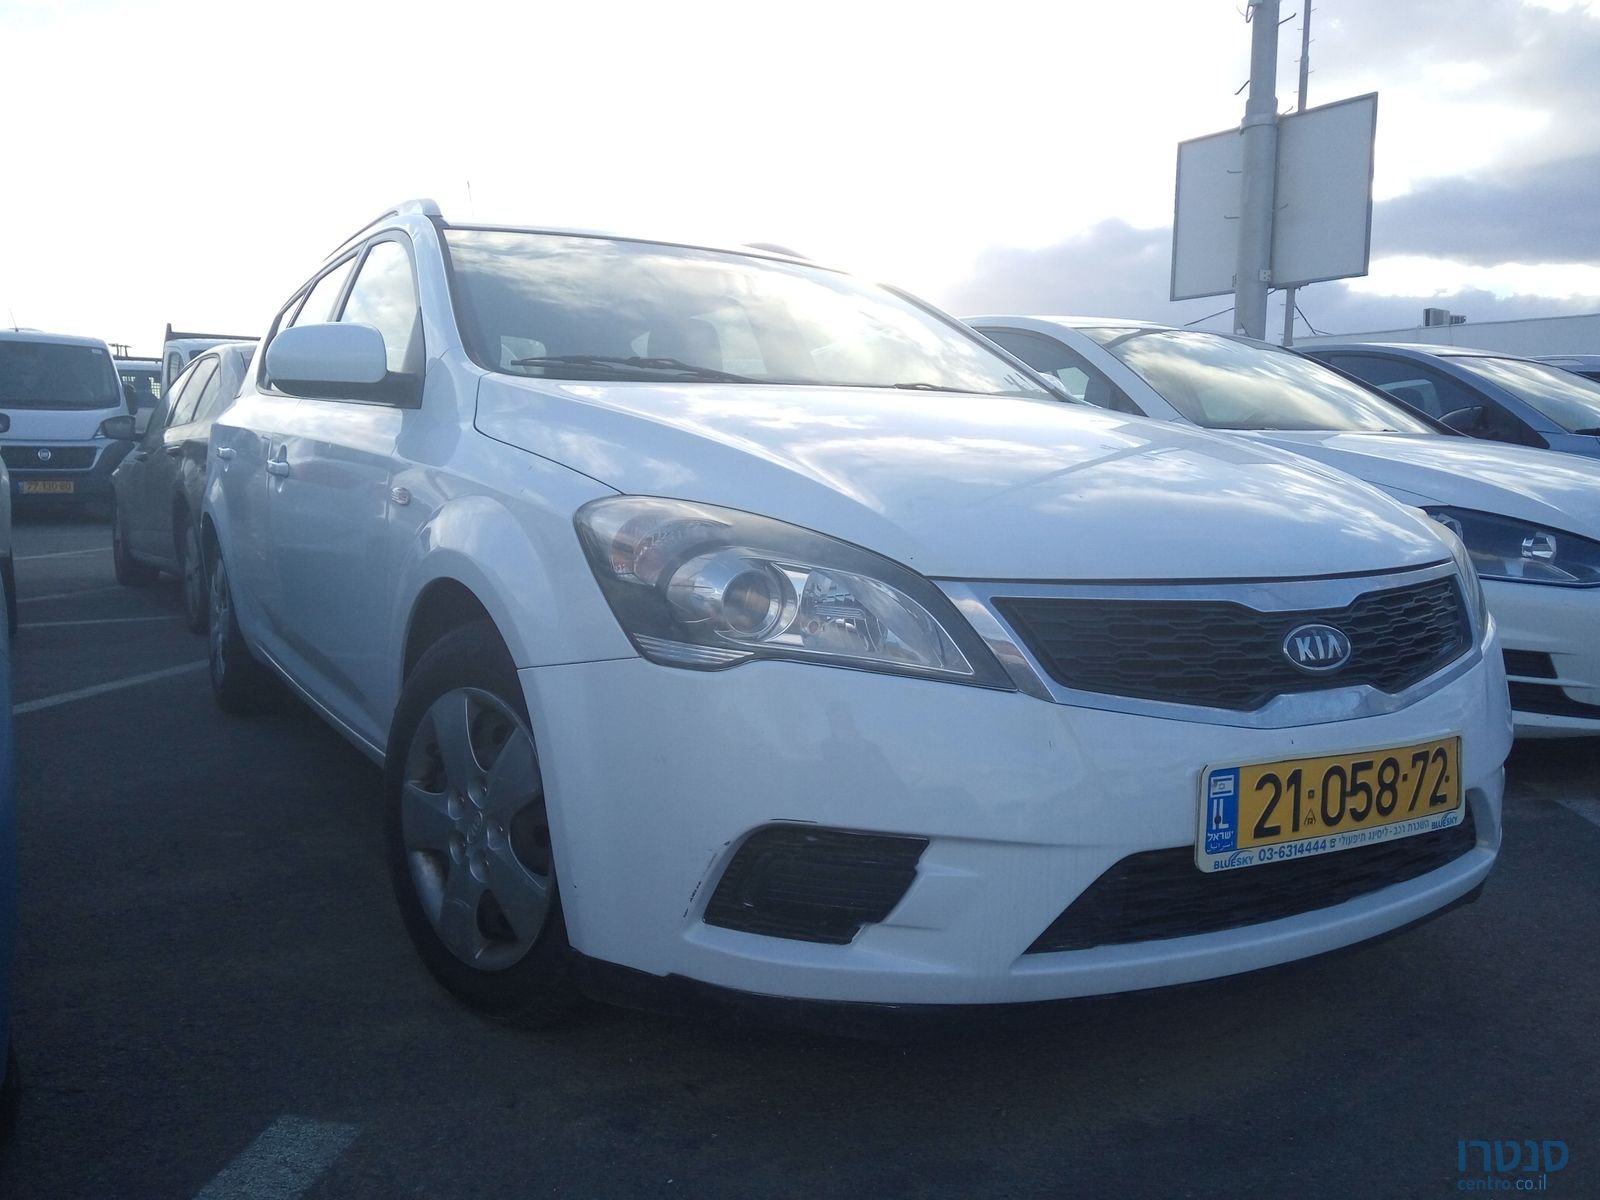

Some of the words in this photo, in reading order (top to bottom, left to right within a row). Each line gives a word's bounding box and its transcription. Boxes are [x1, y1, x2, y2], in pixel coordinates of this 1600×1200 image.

[1294, 633, 1344, 661] KIA
[1212, 799, 1229, 830] IL
[1431, 814, 1458, 830] BLUESKY
[1207, 830, 1234, 842] ישראל
[1258, 839, 1327, 862] 03-6314444
[1213, 854, 1254, 870] BLUESKY
